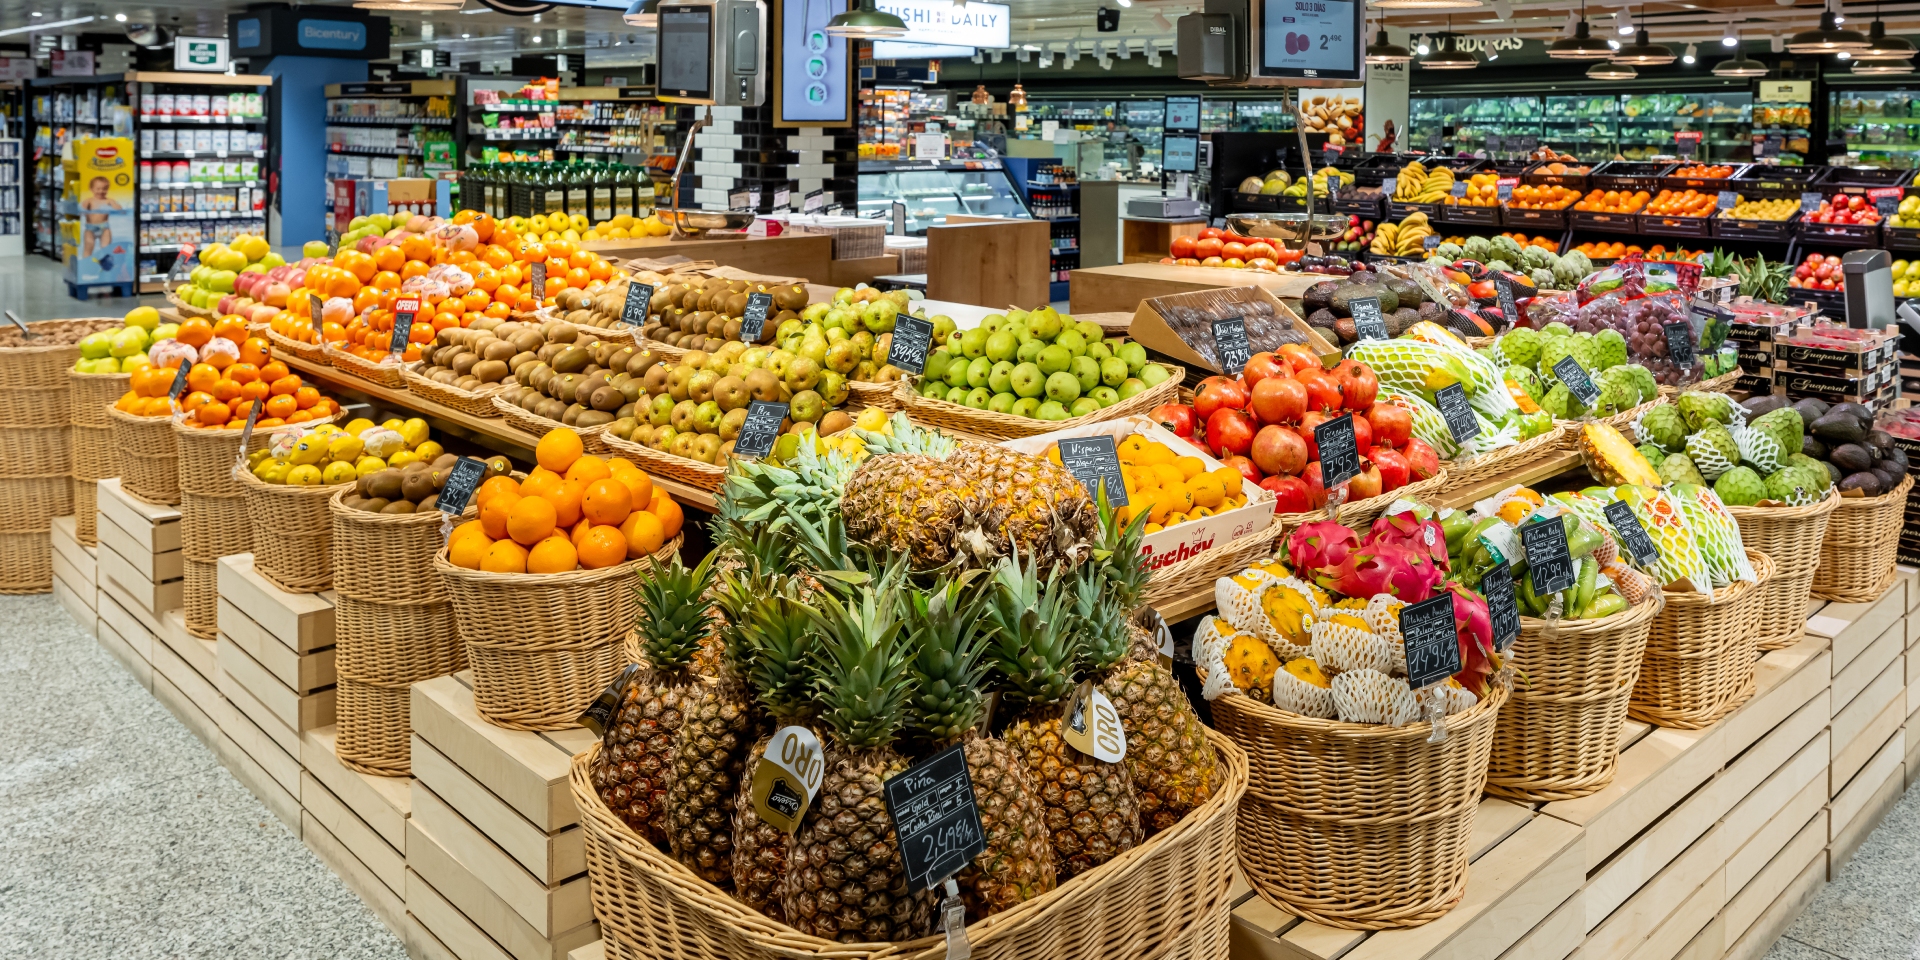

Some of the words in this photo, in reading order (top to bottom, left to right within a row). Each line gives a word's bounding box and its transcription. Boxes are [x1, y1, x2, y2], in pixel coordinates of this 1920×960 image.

[1295, 2, 1309, 11] SOLO
[1309, 2, 1313, 12] 3
[1313, 1, 1326, 13] DÍAS
[304, 26, 361, 41] Bicentury
[1209, 26, 1227, 34] DIBAL
[1436, 36, 1524, 52] VRDURAS
[1675, 132, 1701, 140] OFERTA
[1870, 188, 1903, 199] OFERTA
[396, 299, 420, 312] OFERTA
[1791, 347, 1850, 361] Guaperal
[1790, 377, 1849, 392] Guaperal
[1326, 452, 1354, 479] 7'95
[1095, 703, 1121, 755] ORO
[781, 732, 823, 790] ORO
[903, 768, 936, 794] Piña
[911, 796, 930, 817] Gold
[955, 794, 963, 807] 5
